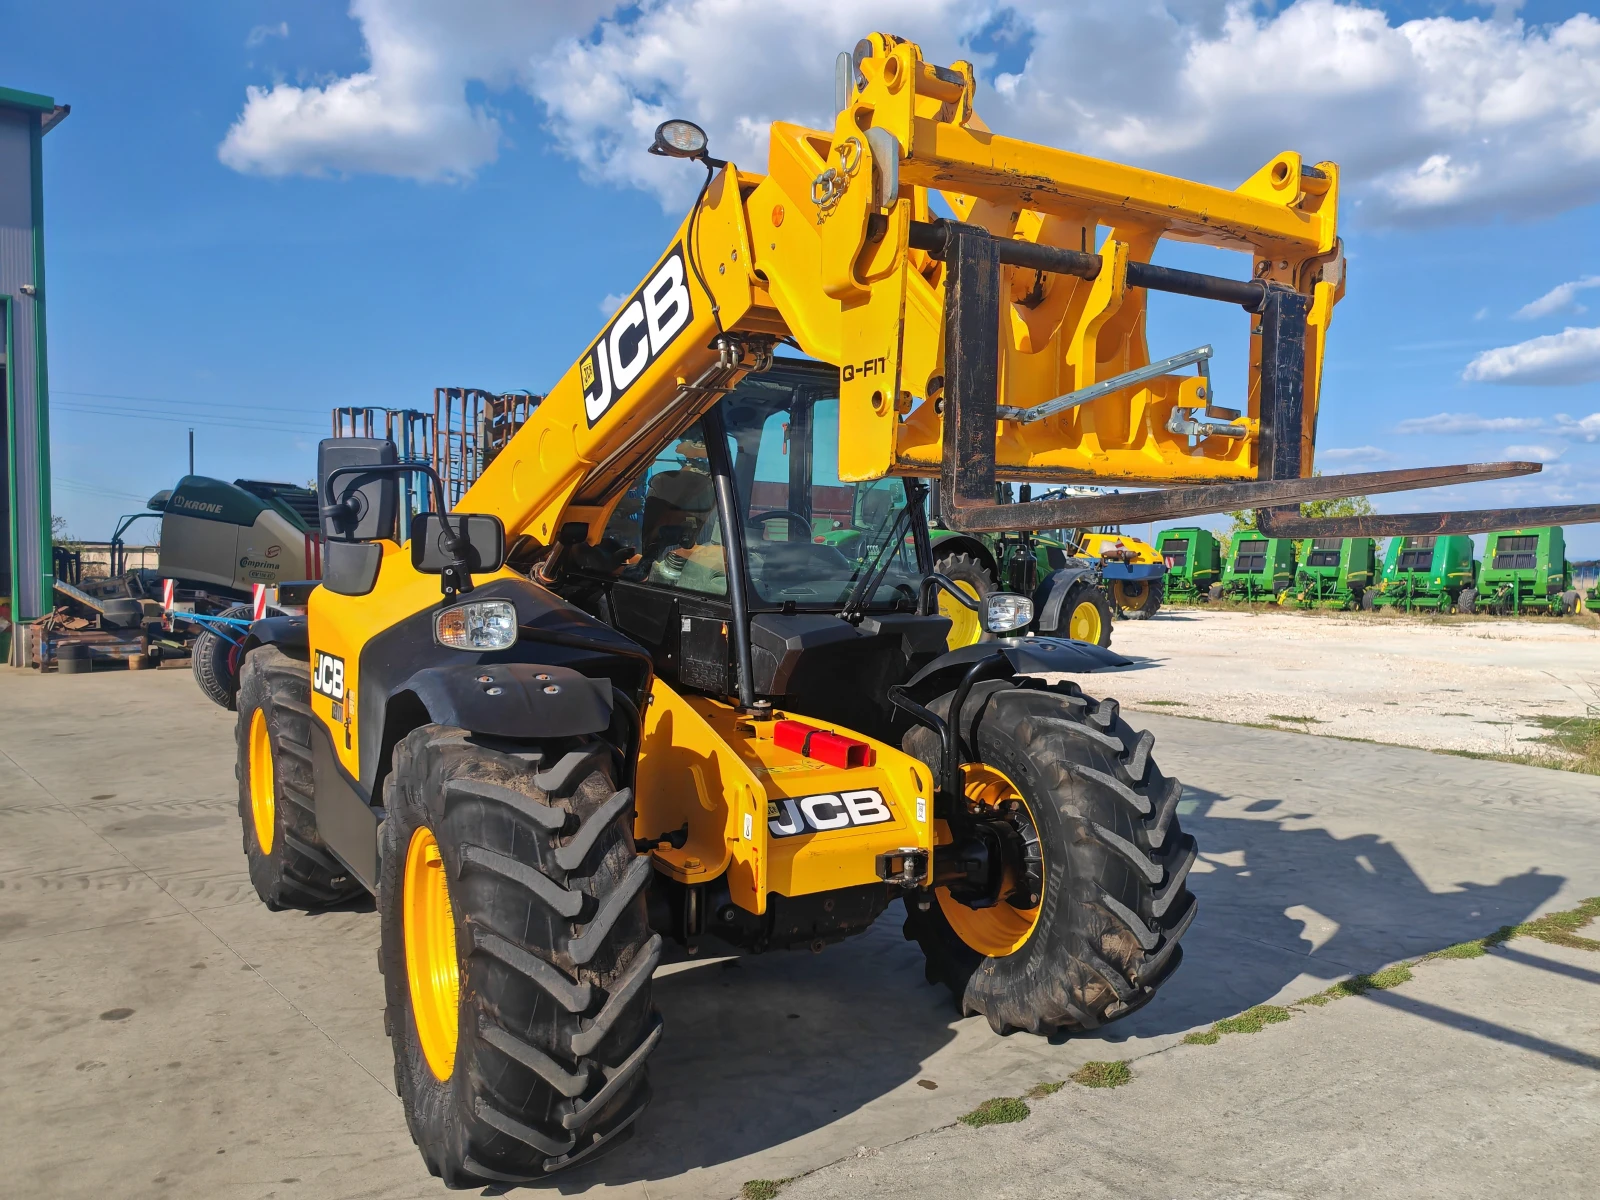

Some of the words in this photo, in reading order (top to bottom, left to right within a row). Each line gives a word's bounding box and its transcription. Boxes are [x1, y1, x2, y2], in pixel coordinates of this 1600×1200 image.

[585, 255, 690, 420] JCB
[843, 357, 885, 382] Q-FIT
[184, 500, 223, 514] KRONE
[240, 556, 280, 570] Comprima
[314, 654, 344, 699] JCB
[768, 790, 891, 835] JCB
